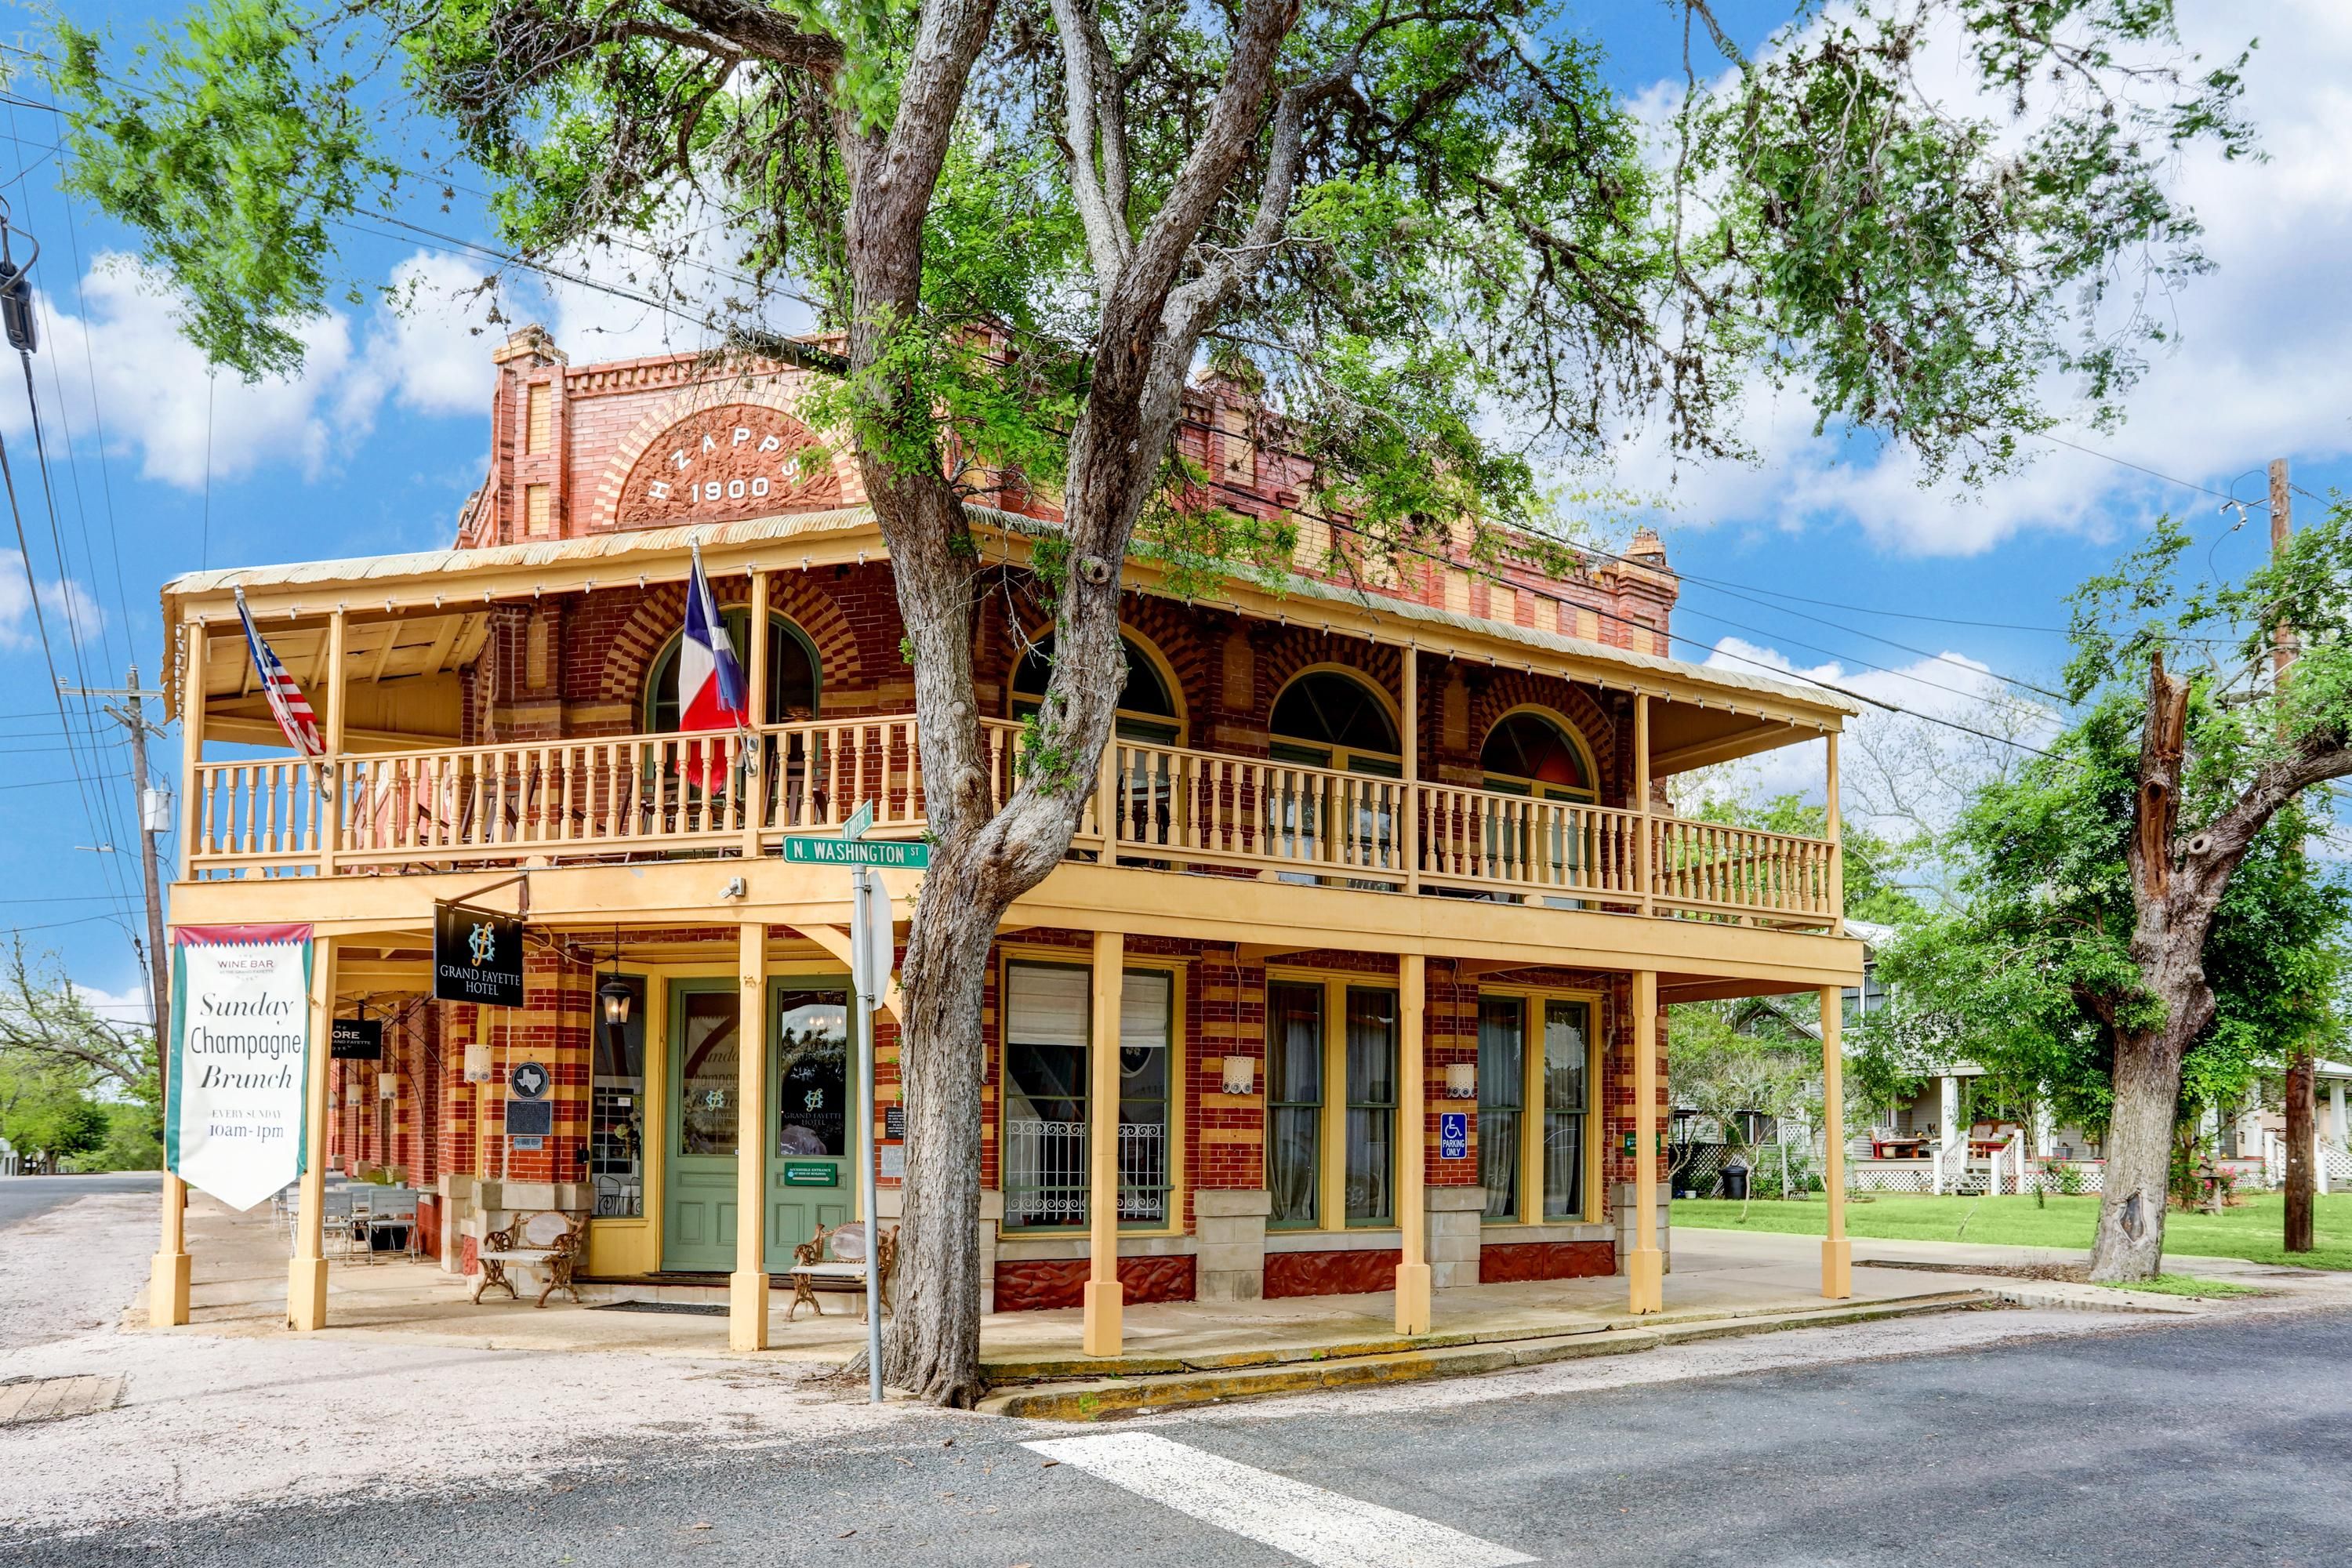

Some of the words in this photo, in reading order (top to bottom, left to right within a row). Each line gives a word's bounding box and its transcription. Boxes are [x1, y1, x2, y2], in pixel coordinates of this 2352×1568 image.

[691, 477, 769, 503] 1900
[793, 840, 808, 859] N.
[814, 841, 905, 864] WASHINGTON
[910, 847, 920, 856] ST
[217, 960, 248, 968] WINE
[250, 960, 274, 968] BAR
[440, 964, 479, 981] GRAND
[482, 970, 521, 986] FAYETTE
[466, 980, 499, 996] HOTEL
[200, 993, 293, 1025] Sunday
[191, 1026, 301, 1060] Champagne
[332, 1030, 360, 1040] ORE
[200, 1064, 292, 1090] Brunch
[212, 1109, 243, 1120] EVERY
[245, 1109, 281, 1120] SUNDAY
[1443, 1139, 1465, 1148] PARKING
[1446, 1148, 1461, 1156] ONLY
